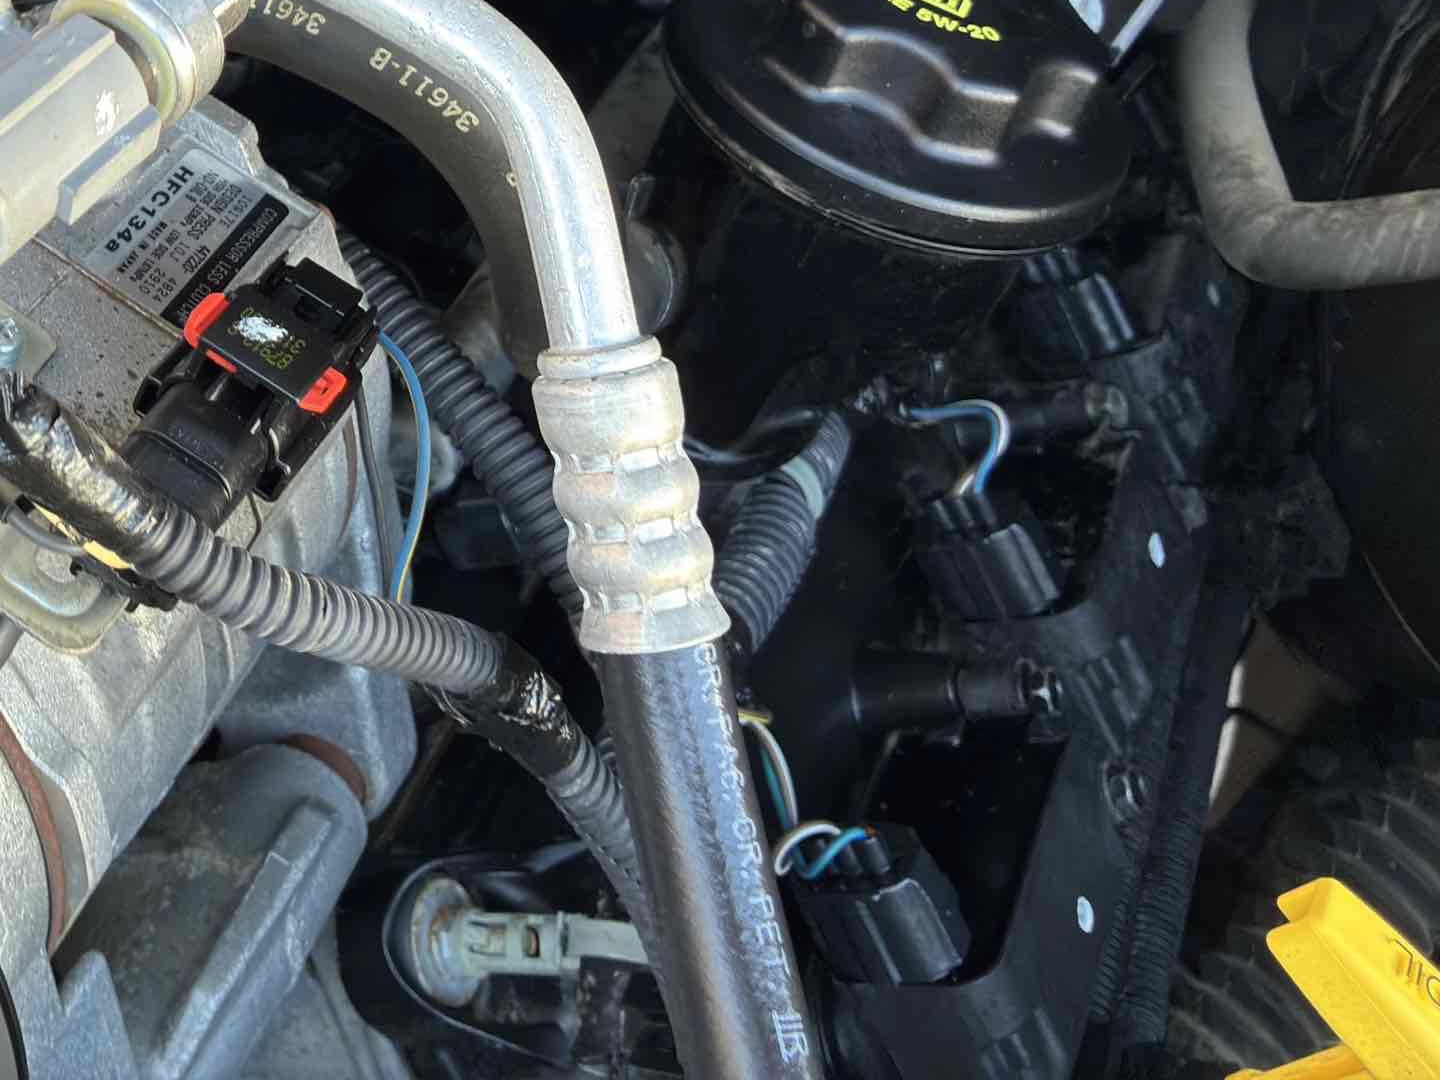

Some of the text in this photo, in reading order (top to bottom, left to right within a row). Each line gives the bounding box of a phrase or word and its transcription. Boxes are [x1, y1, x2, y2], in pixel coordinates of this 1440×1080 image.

[915, 6, 1001, 42] 5W-20
[368, 46, 481, 133] 34611-B
[103, 163, 194, 257] HFC134a
